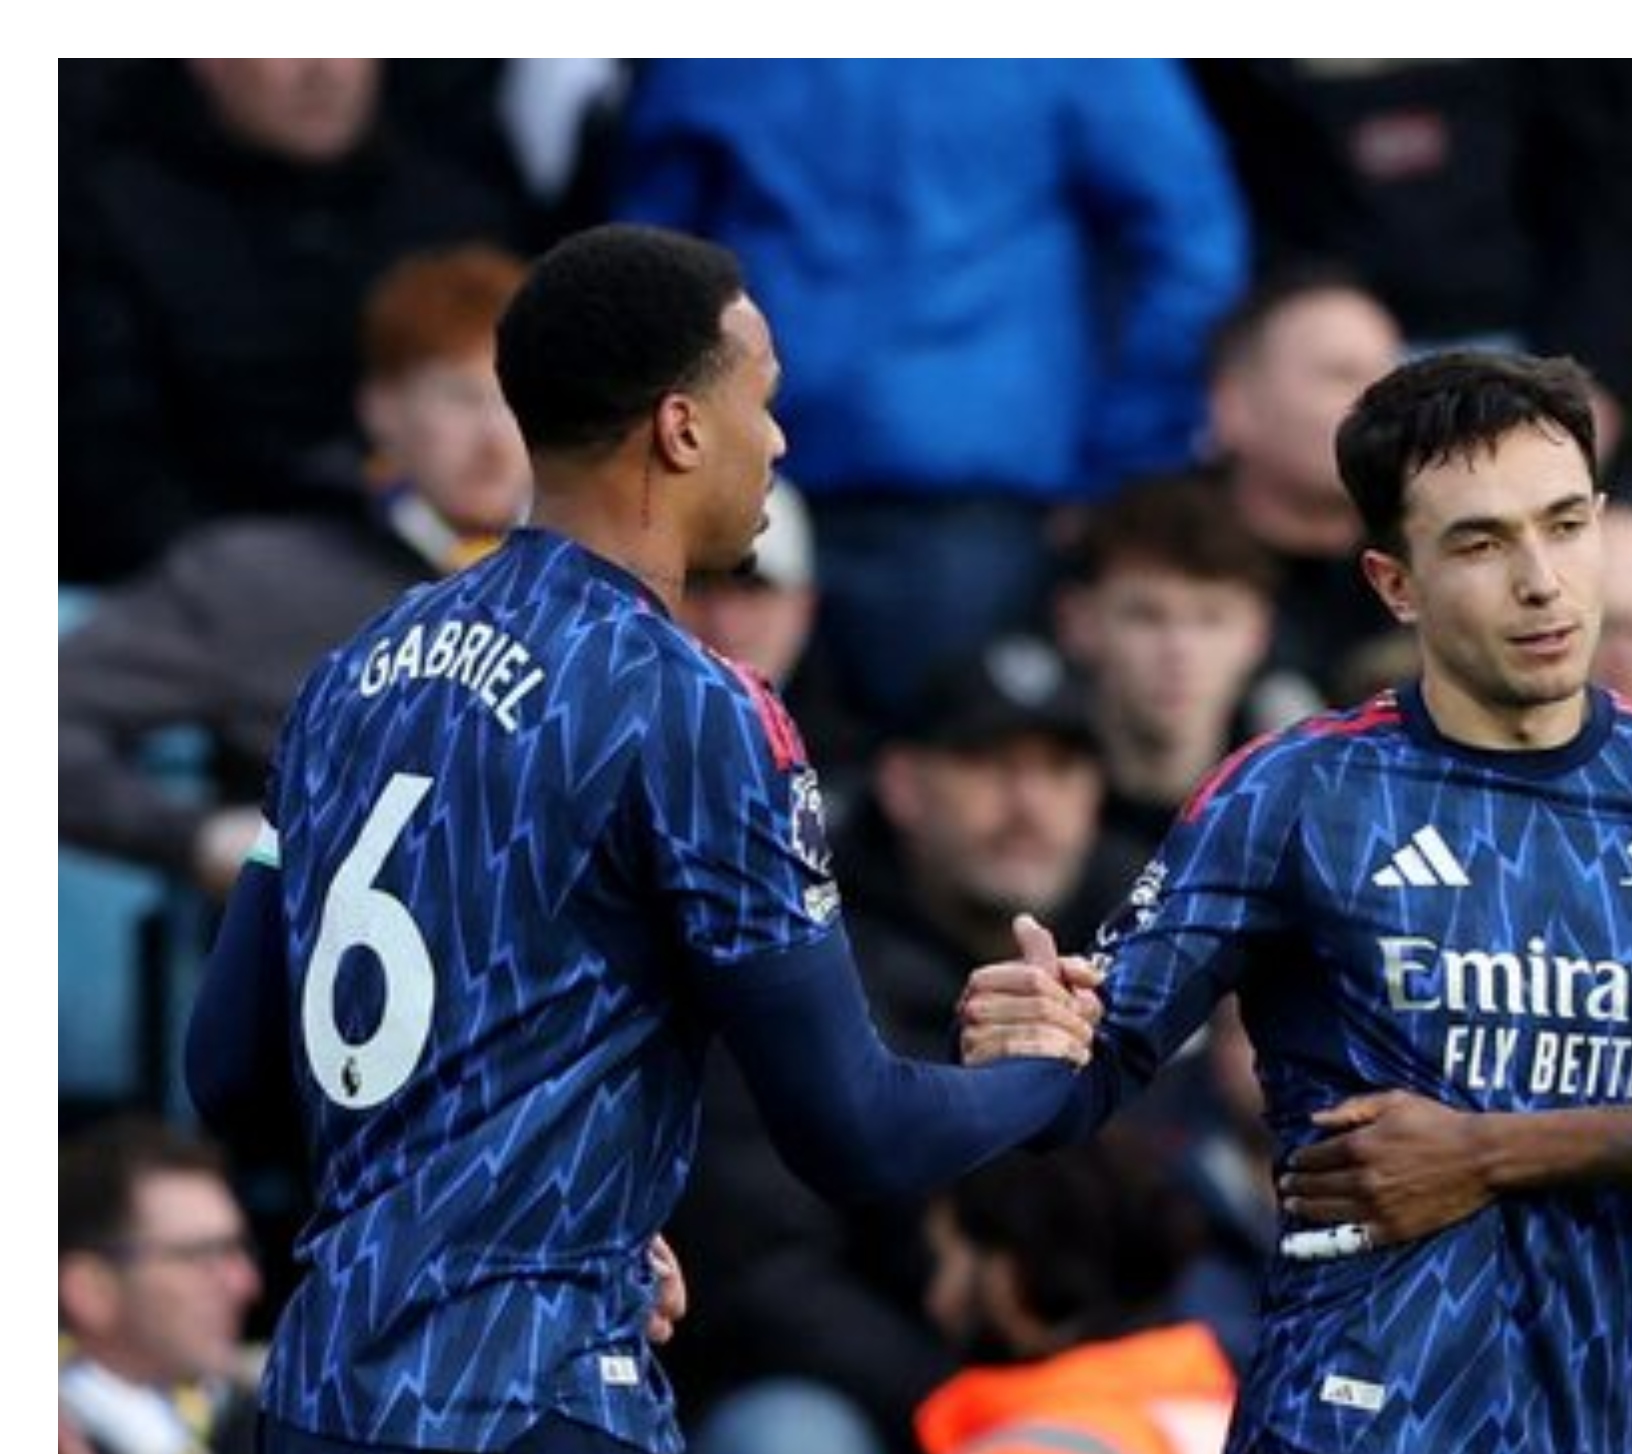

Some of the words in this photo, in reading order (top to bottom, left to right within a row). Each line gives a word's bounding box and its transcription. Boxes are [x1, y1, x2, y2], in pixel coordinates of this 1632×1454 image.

[360, 620, 545, 733] GABRIEL
[302, 772, 435, 1110] 6
[1444, 1025, 1518, 1090] FLY
